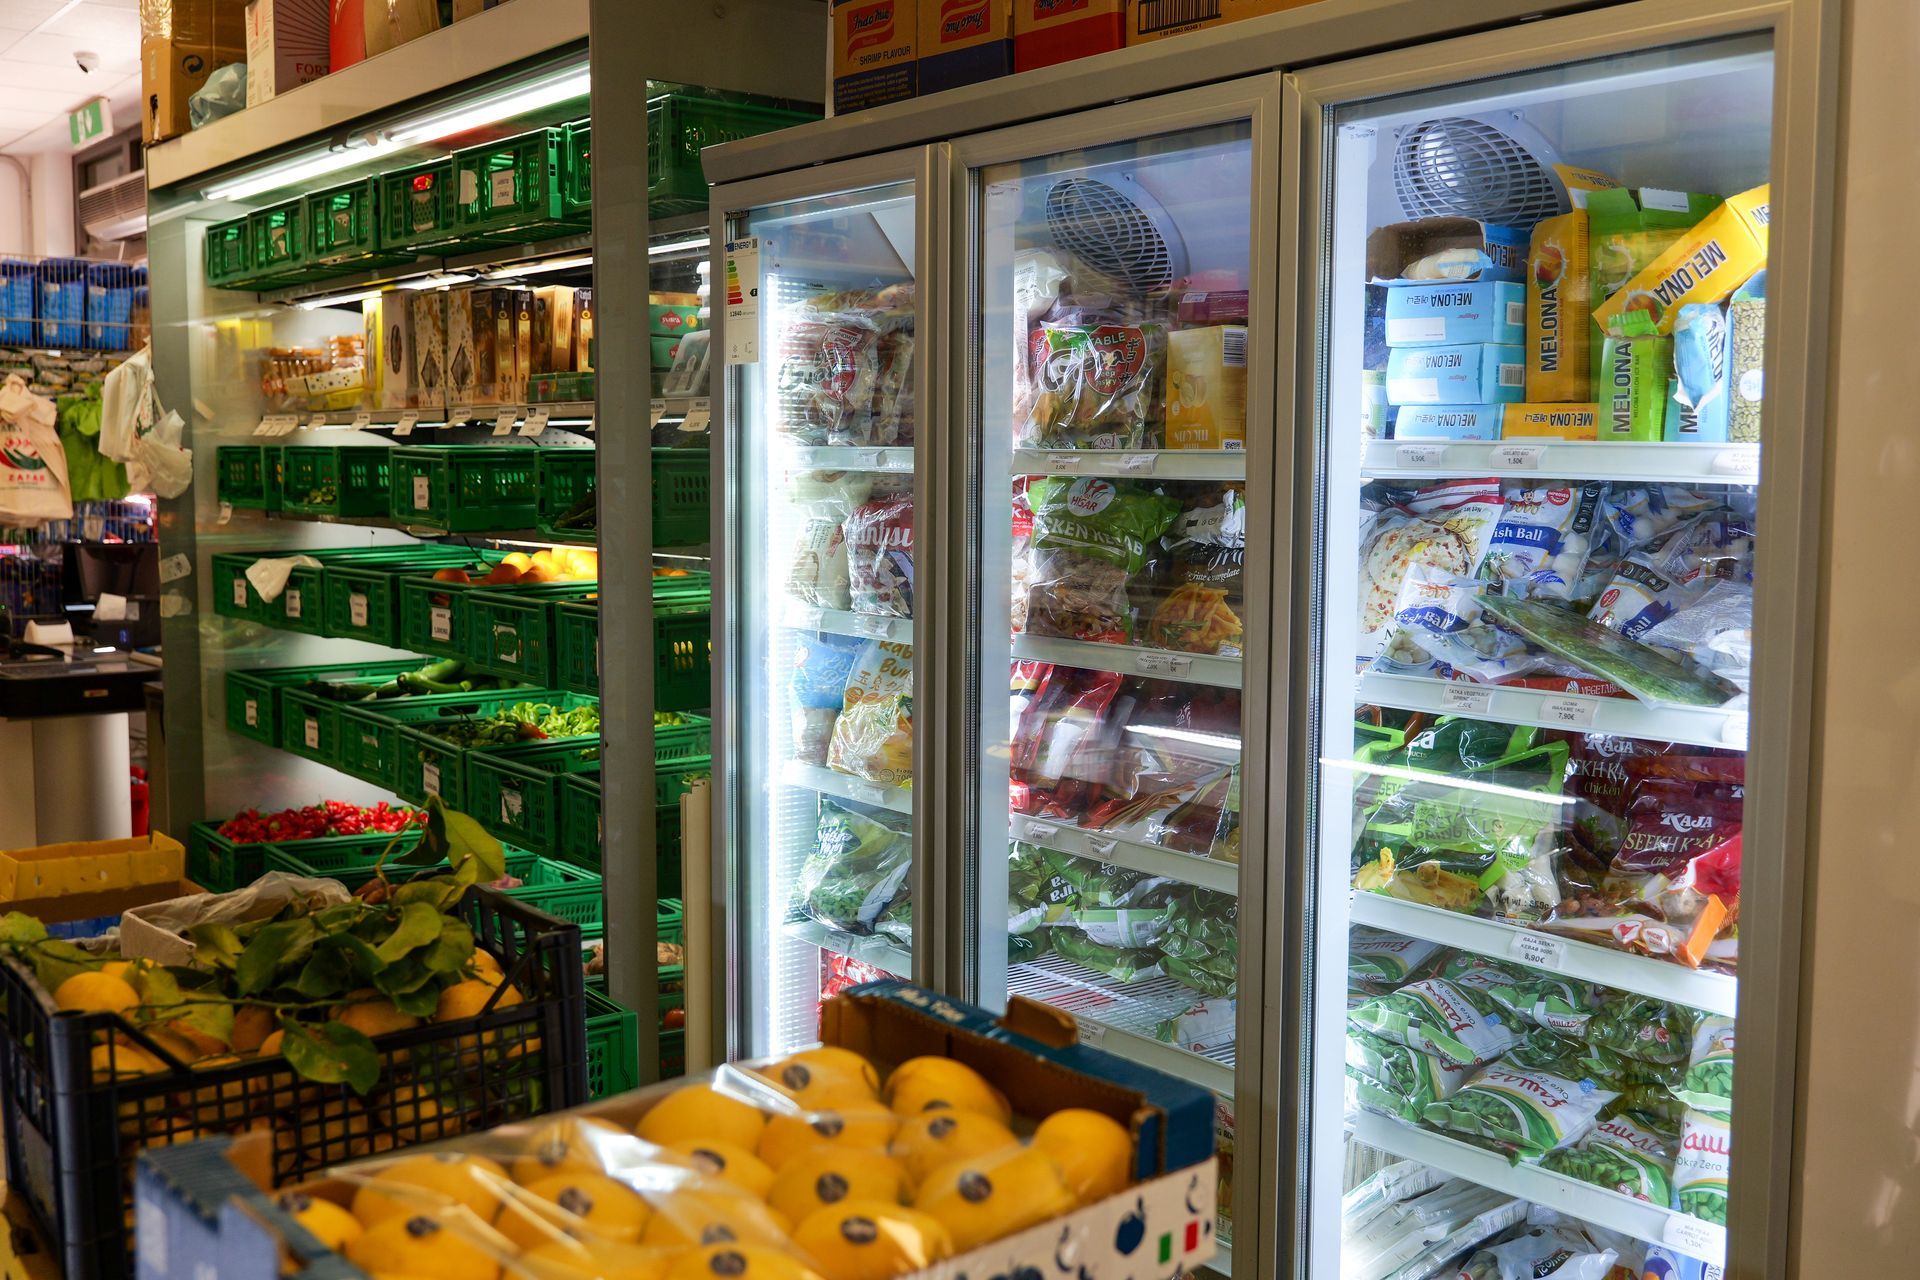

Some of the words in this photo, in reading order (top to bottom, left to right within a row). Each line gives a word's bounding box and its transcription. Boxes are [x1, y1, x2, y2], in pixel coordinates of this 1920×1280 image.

[859, 51, 882, 66] SHRIMP
[882, 45, 911, 61] FLAVOUR
[1486, 242, 1516, 268] MELON
[1653, 239, 1727, 306] MELONA
[1431, 292, 1472, 307] MELONA
[1541, 287, 1558, 373] MELONA
[1088, 331, 1126, 347] TABLE
[1426, 354, 1462, 368] MELONA
[1612, 341, 1632, 433] MELONA
[1438, 414, 1477, 426] MELONA
[1550, 412, 1594, 426] MELONA
[1492, 526, 1513, 538] ish
[1516, 527, 1543, 541] Ball
[1626, 616, 1652, 640] Ball
[1558, 712, 1575, 721] 7,90€
[1584, 733, 1634, 758] RAJA
[1584, 781, 1621, 796] Chicken
[1660, 812, 1713, 833] RAJA
[1524, 953, 1545, 964] 8,90€
[1460, 1006, 1476, 1025] Okra
[1676, 1156, 1698, 1168] Okra
[1699, 1158, 1723, 1171] Zero
